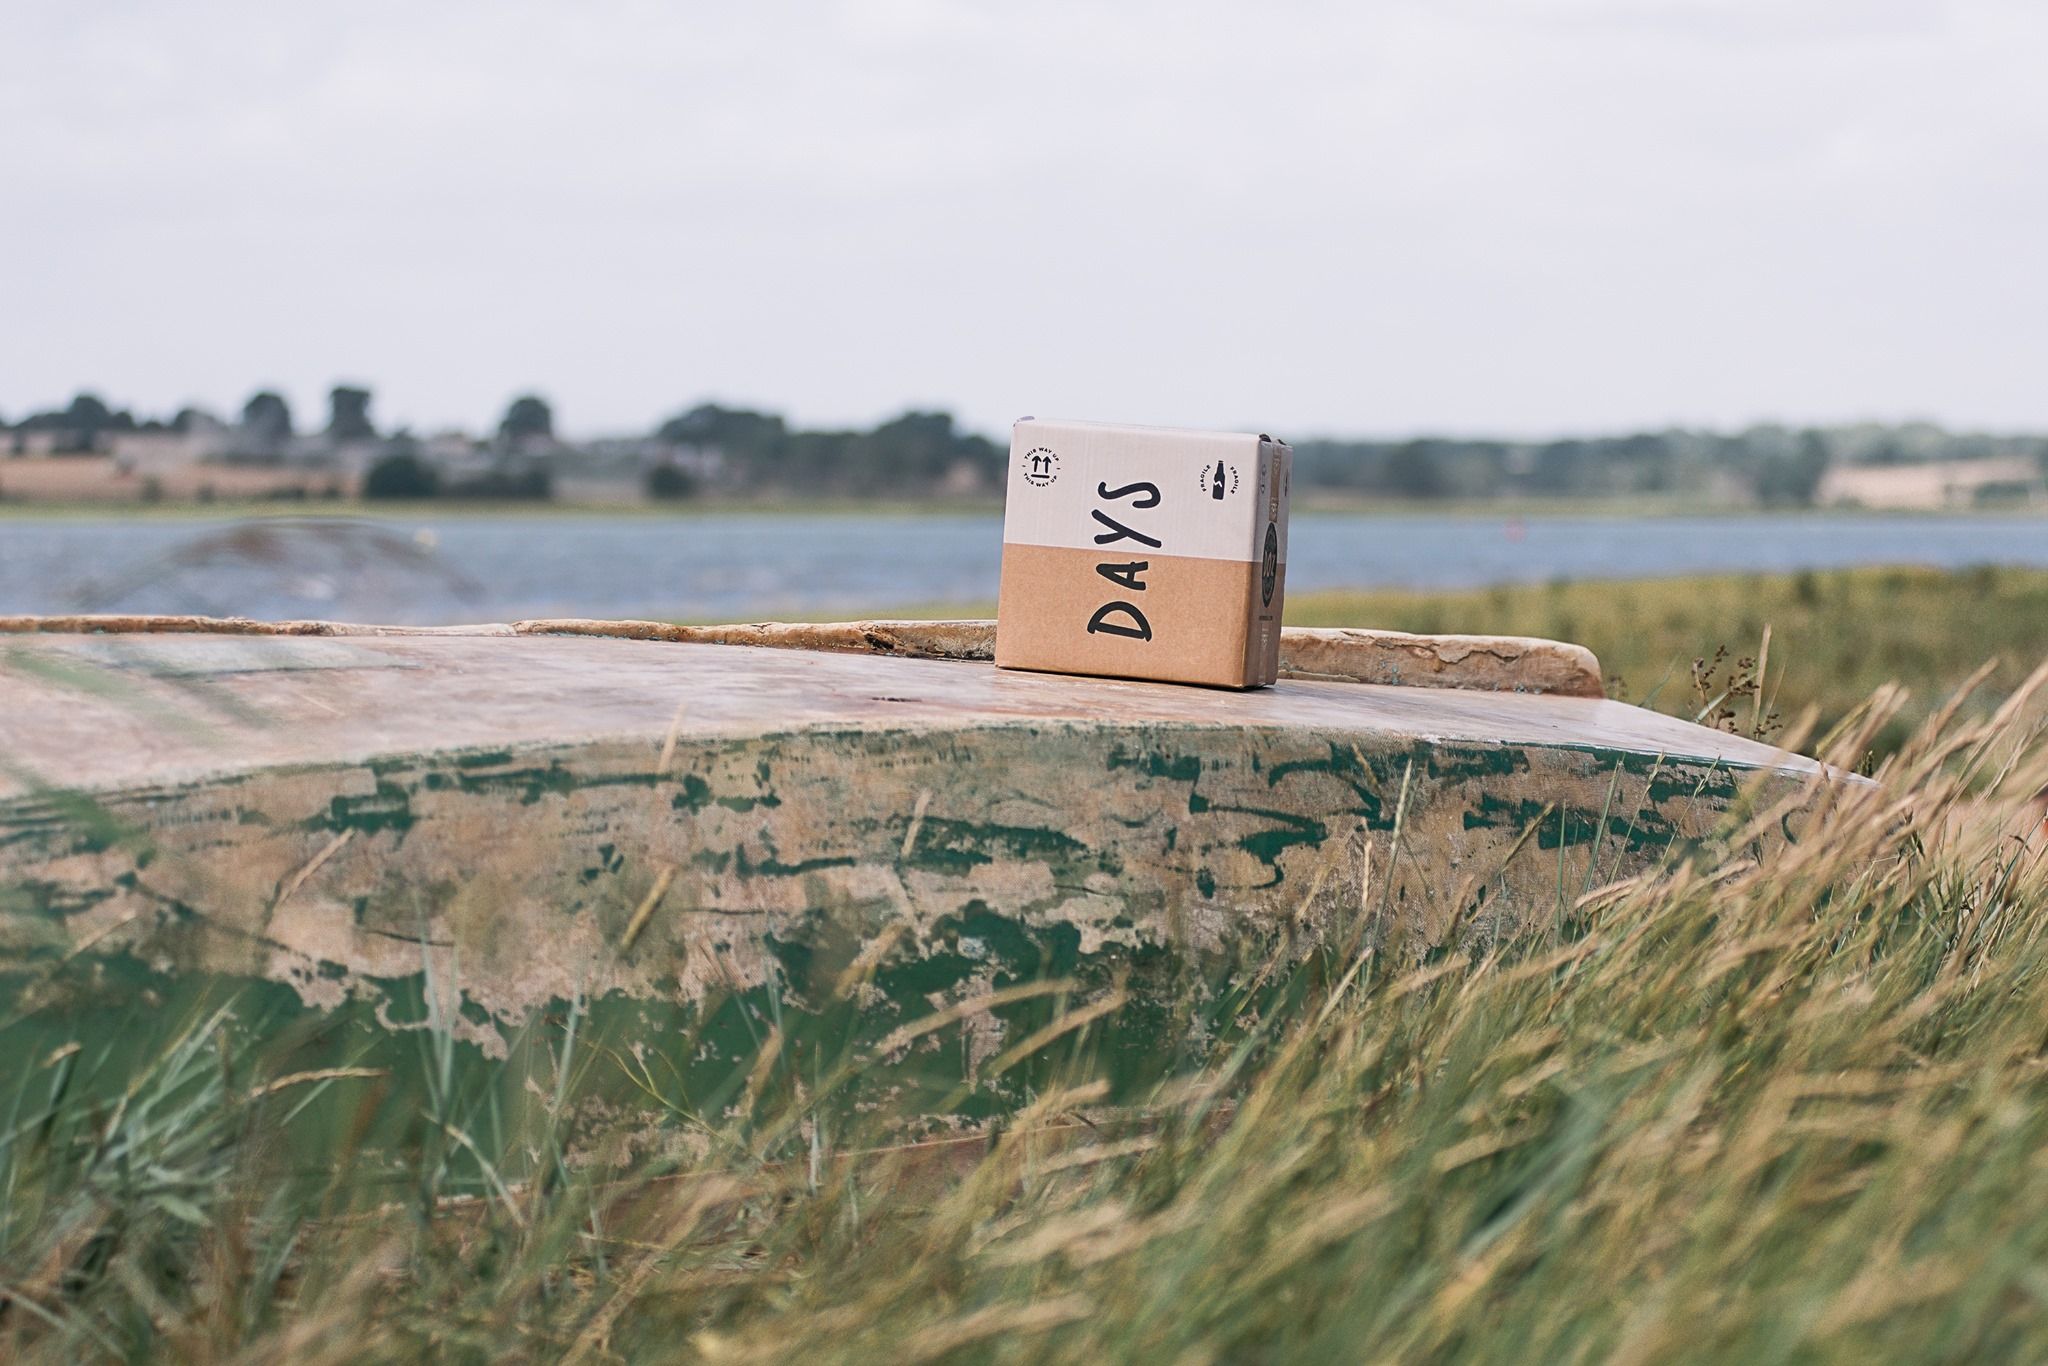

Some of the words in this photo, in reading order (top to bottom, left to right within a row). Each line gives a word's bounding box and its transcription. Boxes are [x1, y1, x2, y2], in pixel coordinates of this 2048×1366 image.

[1024, 448, 1036, 460] THIS
[1052, 453, 1059, 461] UP
[1024, 472, 1034, 485] THIS
[1050, 475, 1057, 484] UP
[1200, 464, 1211, 492] FRAGILE
[1230, 466, 1239, 494] FRAGILE
[1087, 481, 1162, 643] DAYS
